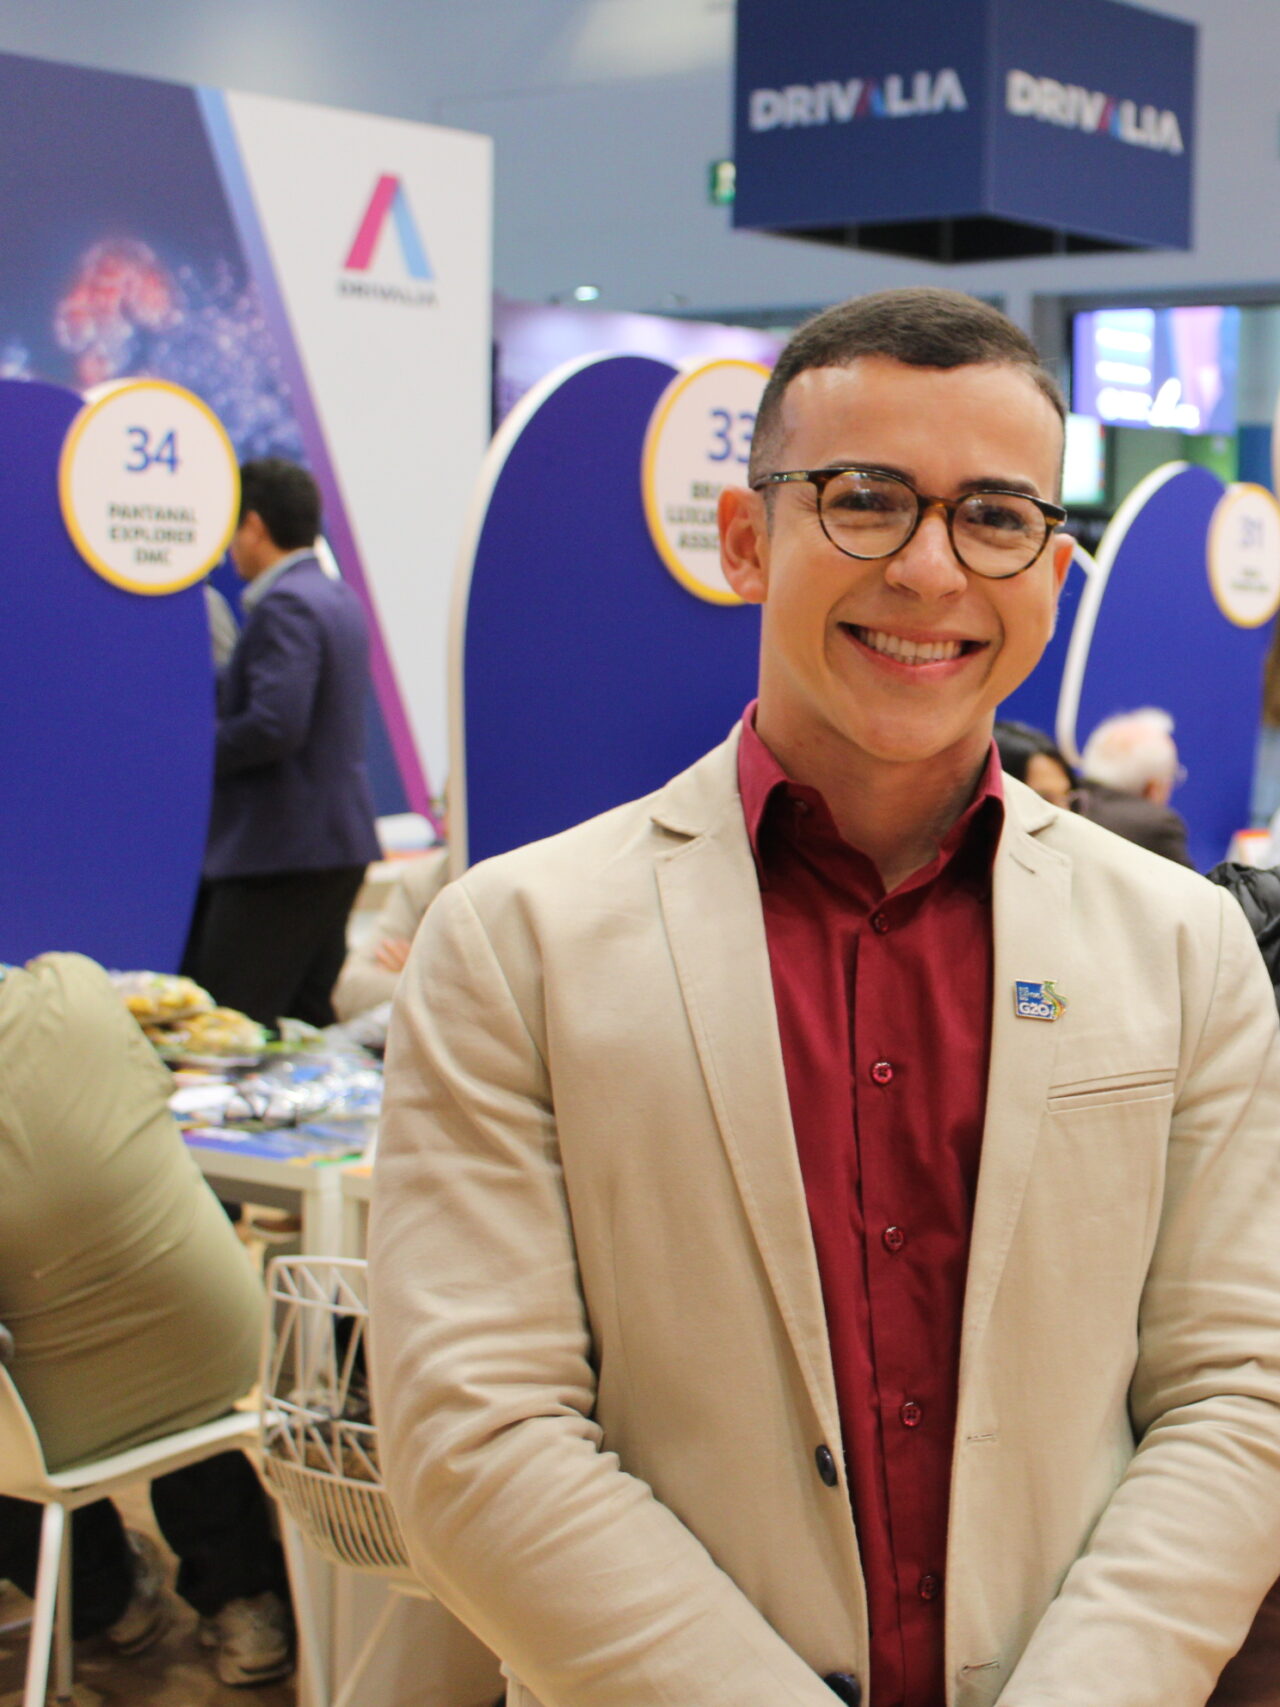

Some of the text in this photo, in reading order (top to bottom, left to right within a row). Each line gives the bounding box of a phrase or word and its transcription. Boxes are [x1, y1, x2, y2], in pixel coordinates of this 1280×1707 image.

[749, 68, 967, 132] DRIVALIA
[1006, 69, 1184, 155] DRIVALIA
[125, 426, 179, 474] 34
[109, 526, 196, 545] EXPLORER
